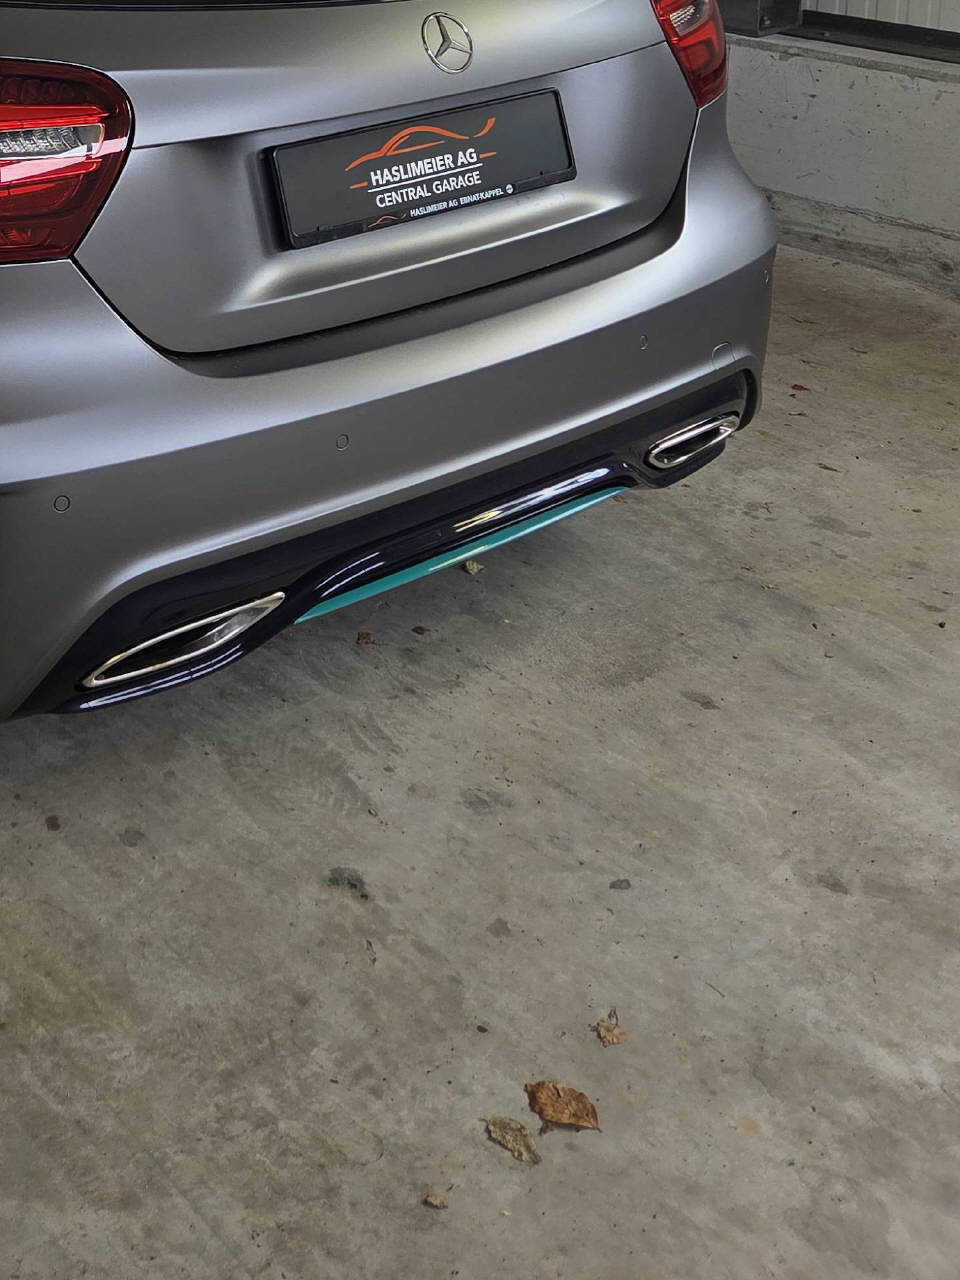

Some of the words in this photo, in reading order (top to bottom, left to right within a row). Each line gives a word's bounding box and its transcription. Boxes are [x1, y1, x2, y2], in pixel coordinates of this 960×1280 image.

[370, 152, 455, 186] HASLIMEIER
[457, 147, 478, 166] AG
[375, 184, 431, 208] CENTRAL
[432, 170, 482, 193] GARAGE
[410, 201, 448, 218] HASLIMEIER
[448, 199, 458, 208] AG
